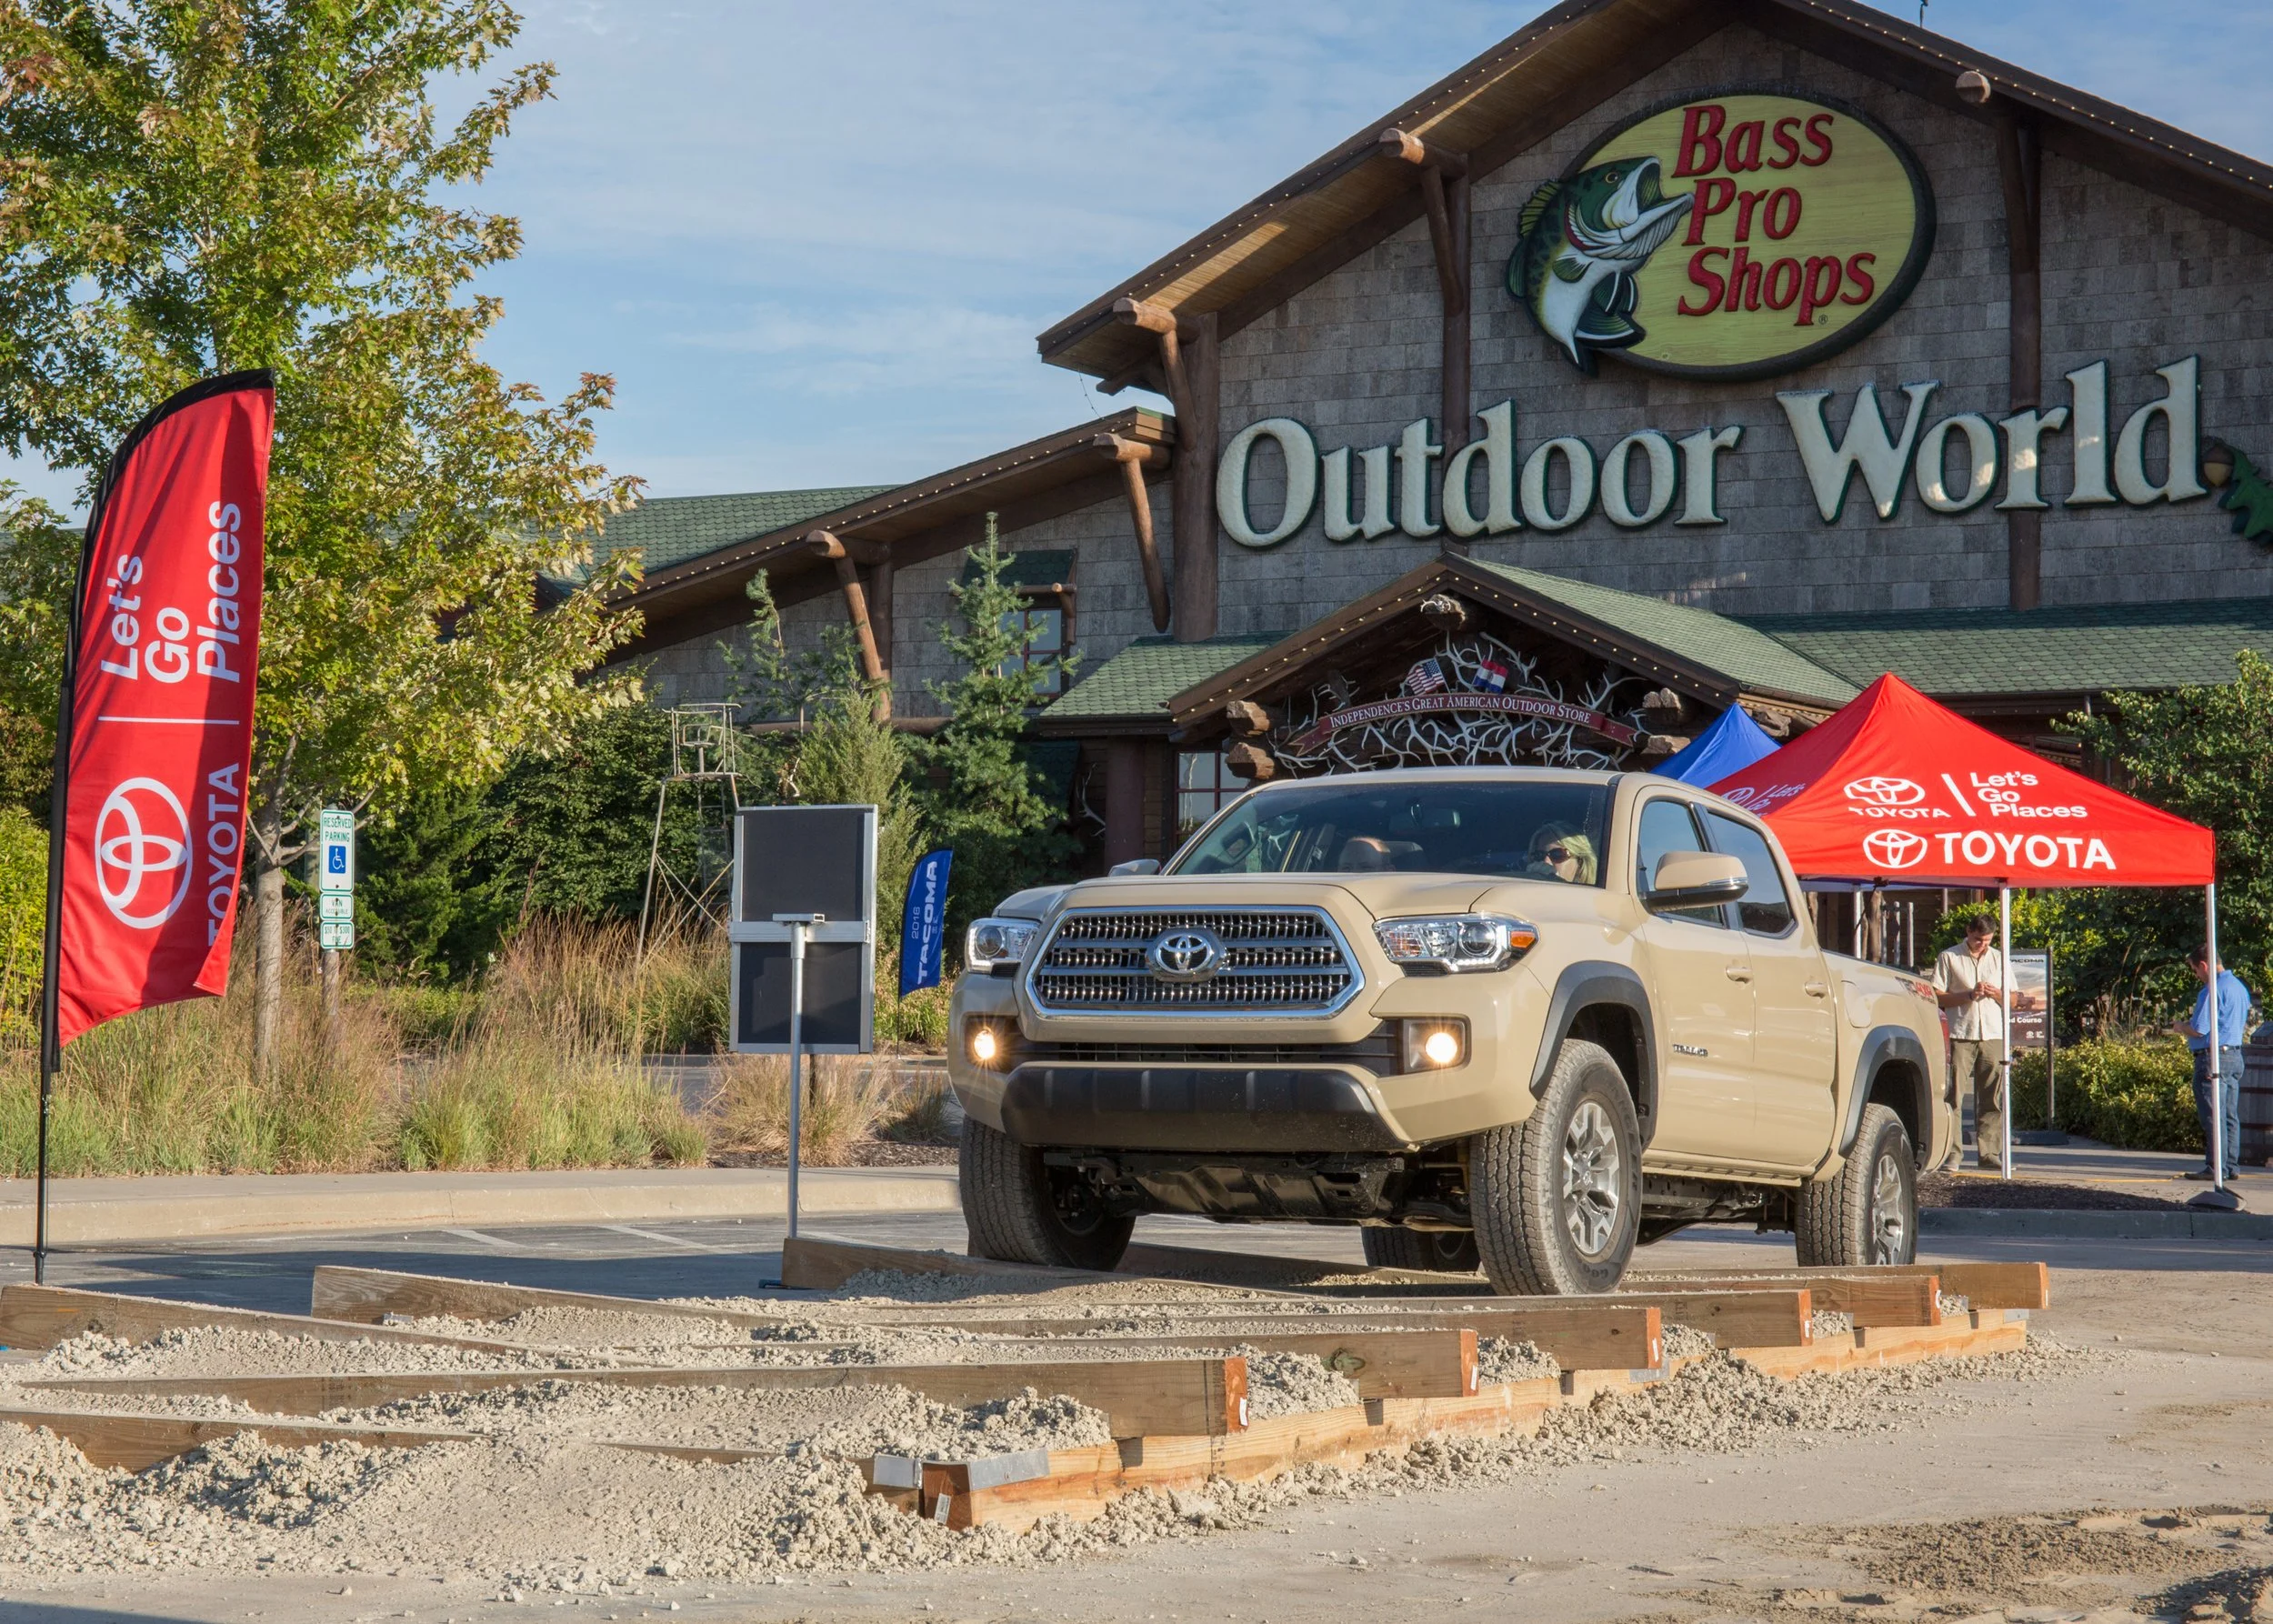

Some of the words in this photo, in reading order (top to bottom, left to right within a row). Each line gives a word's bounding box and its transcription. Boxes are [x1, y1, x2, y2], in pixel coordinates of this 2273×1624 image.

[1671, 104, 1834, 178] Bass
[1681, 176, 1802, 246] Pro
[1677, 246, 1877, 326] Shops
[1216, 397, 1744, 548] Outdoor
[1776, 353, 2208, 525] World
[101, 553, 144, 680] Let's
[197, 500, 242, 684] Places
[145, 606, 190, 685] Go
[1330, 701, 1409, 727] INDEPENDENCE'S
[1412, 697, 1444, 710] GREAT
[1447, 696, 1500, 709] AMERICAN
[1502, 697, 1556, 716] OUTDOOR
[1557, 705, 1590, 724] STORE
[1848, 807, 1952, 819] TOYOTA
[1969, 771, 2038, 787] Let's
[1978, 787, 2020, 803] Go
[1989, 803, 2088, 818] Places
[208, 762, 242, 947] TOYOTA
[323, 817, 352, 829] RESERVED
[325, 830, 350, 842] PARKING
[1935, 830, 2117, 871] TOYOTA
[917, 860, 938, 985] TACOMA
